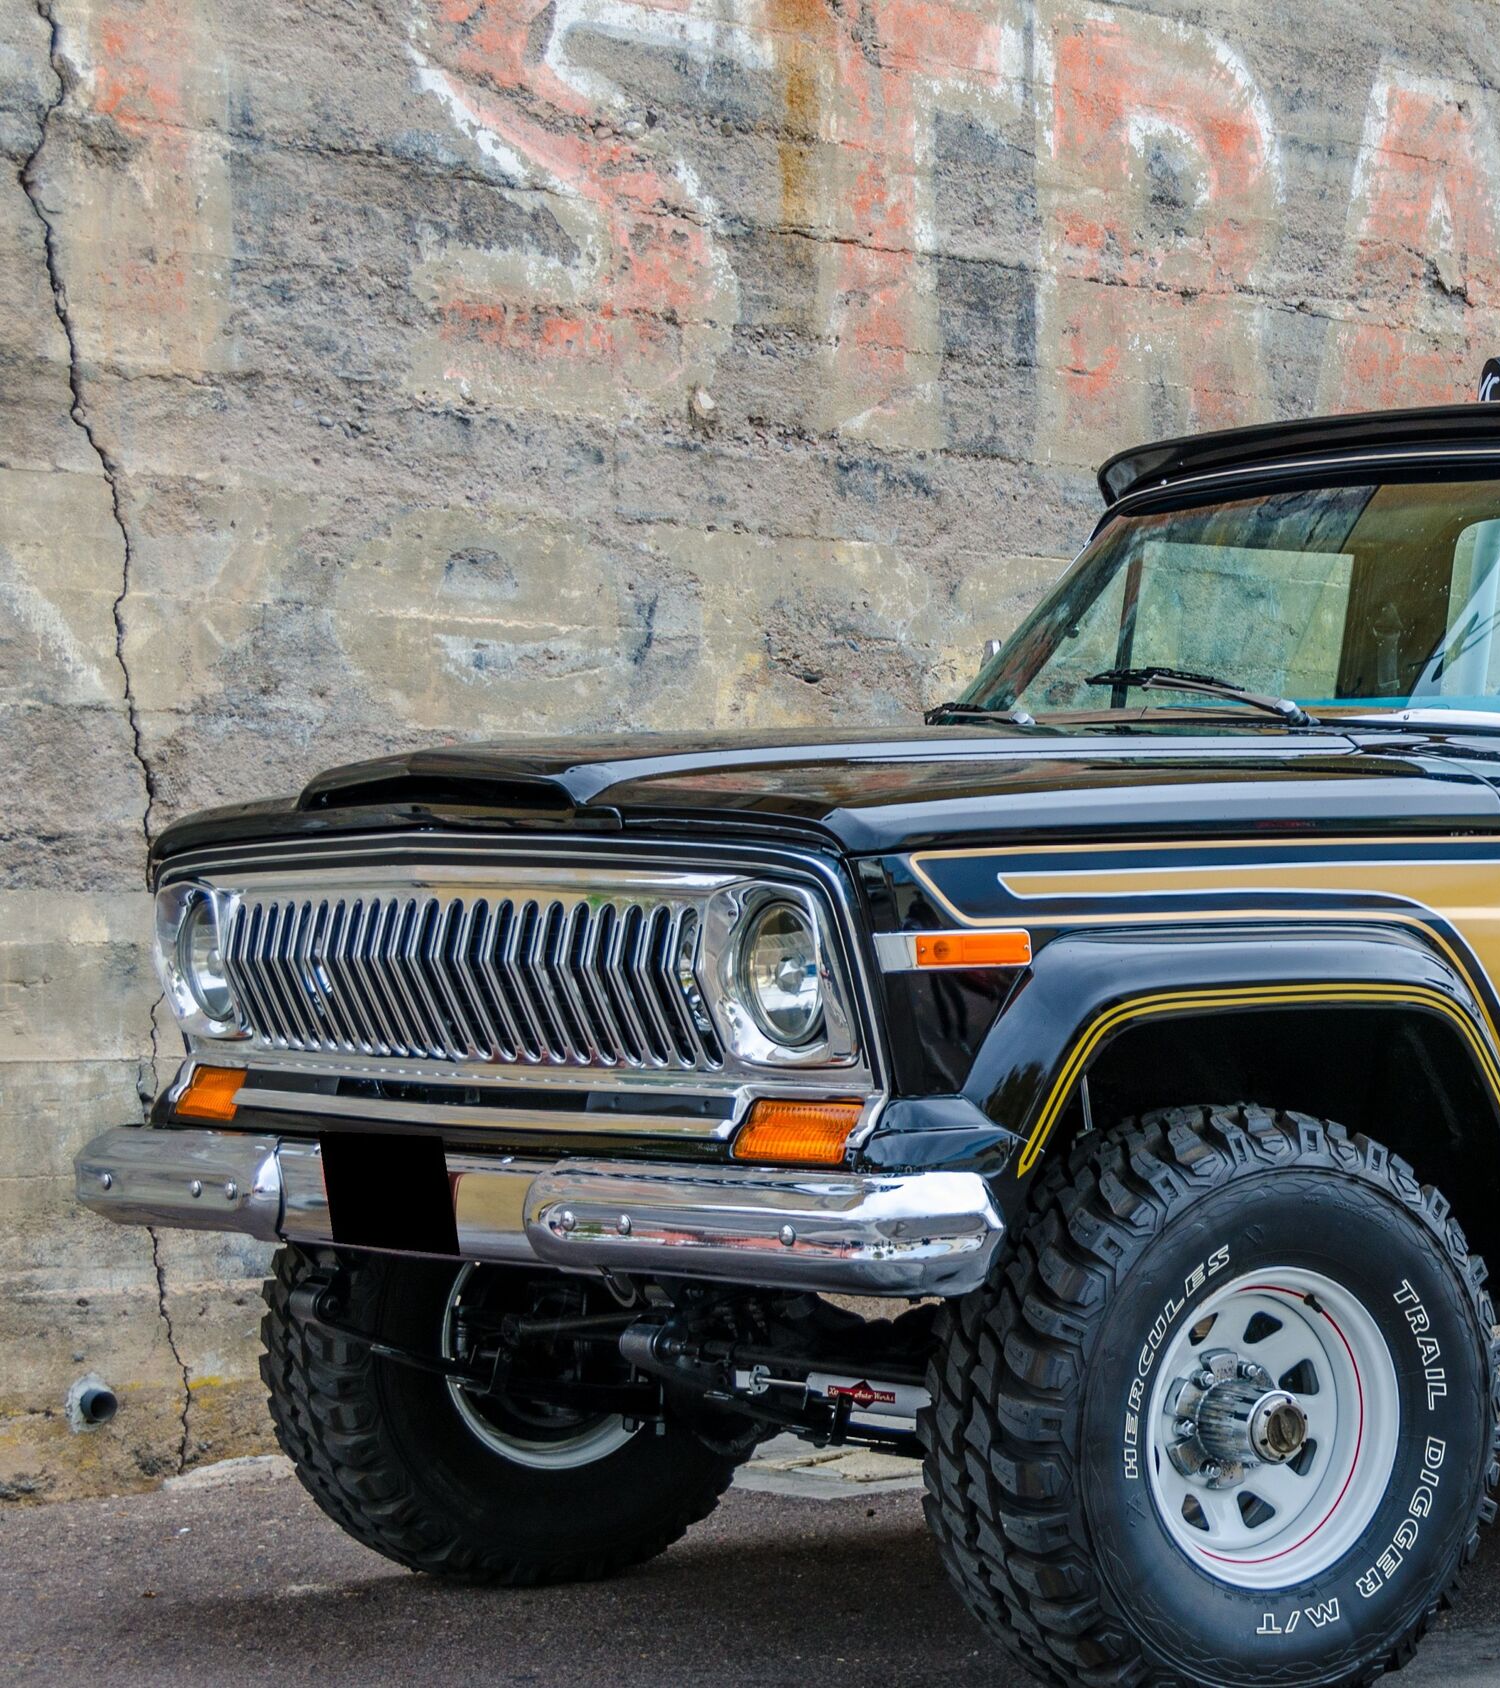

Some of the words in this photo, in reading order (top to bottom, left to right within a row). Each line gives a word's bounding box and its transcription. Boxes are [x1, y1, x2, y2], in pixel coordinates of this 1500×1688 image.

[1124, 1245, 1229, 1479] HERCULES
[1393, 1279, 1448, 1411] TRAIL
[1356, 1436, 1446, 1598] DIGGER
[1256, 1598, 1341, 1635] M/T
